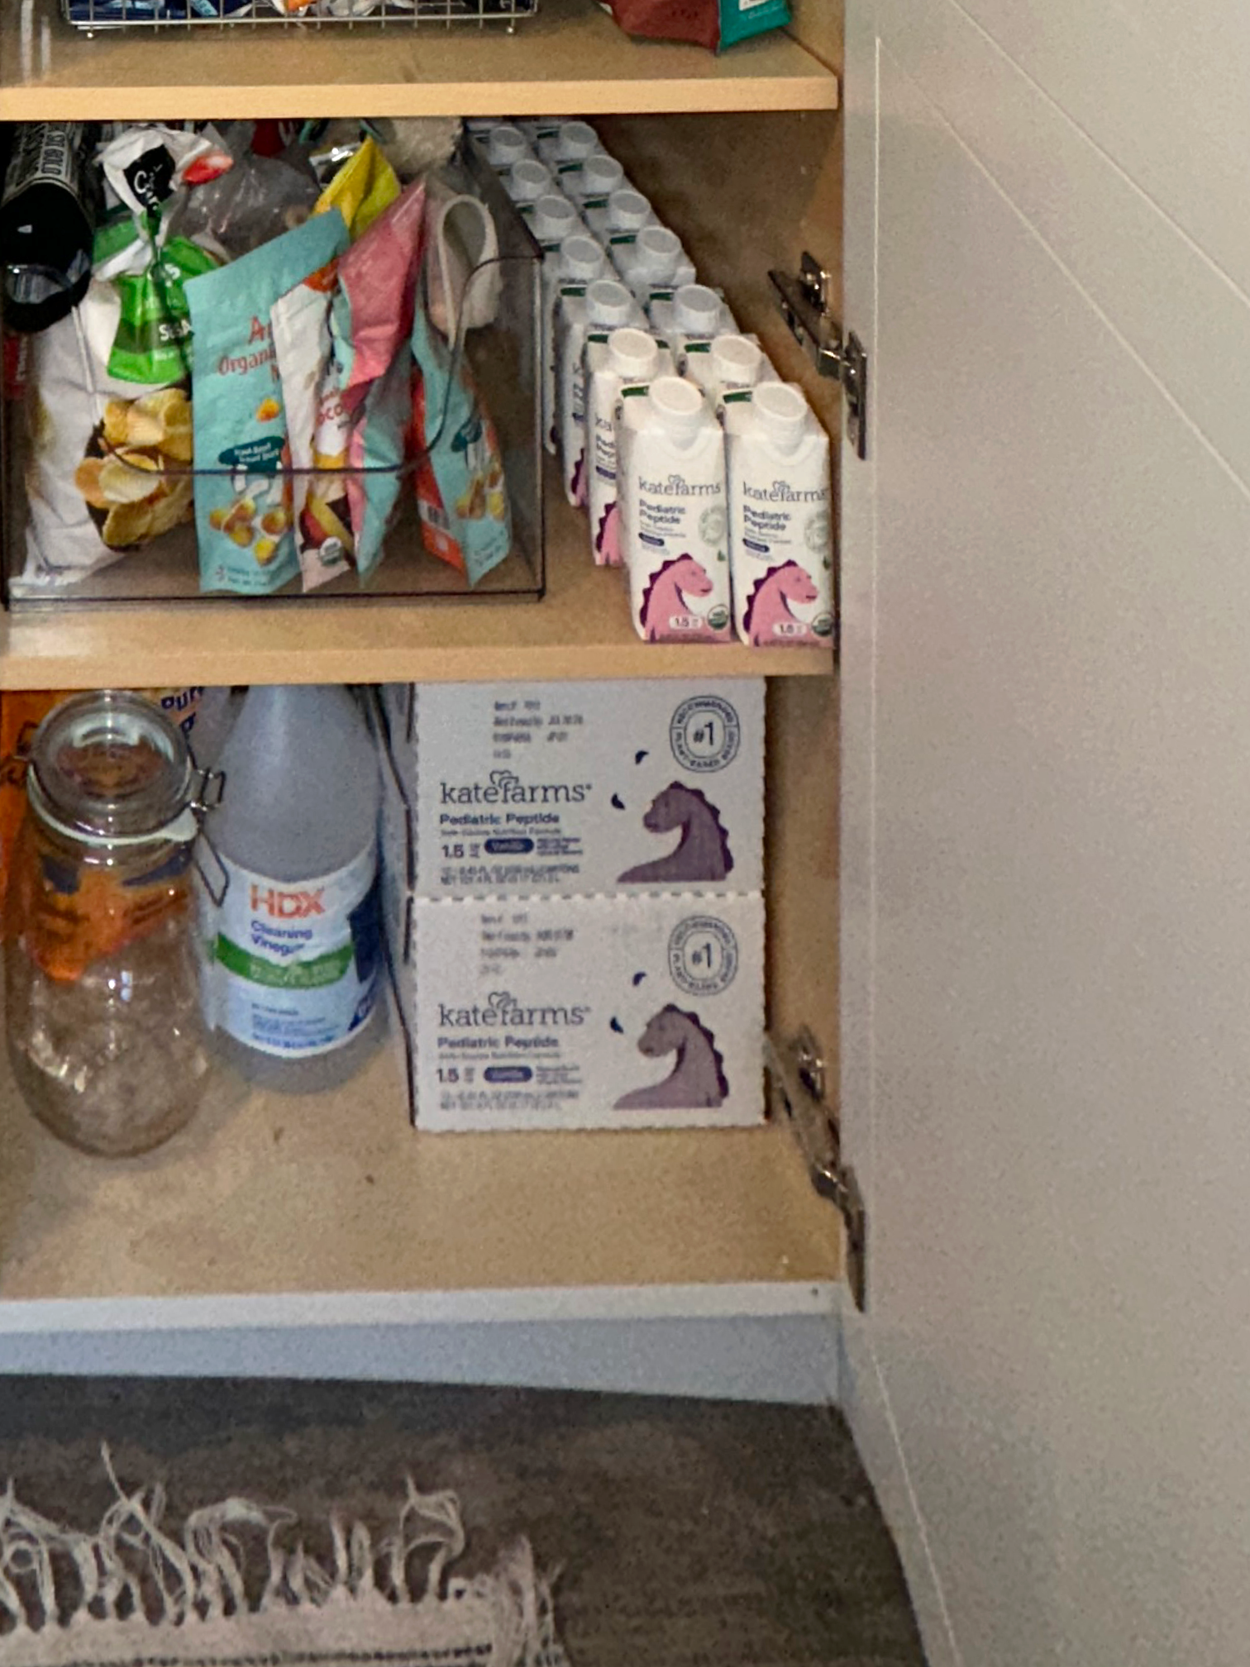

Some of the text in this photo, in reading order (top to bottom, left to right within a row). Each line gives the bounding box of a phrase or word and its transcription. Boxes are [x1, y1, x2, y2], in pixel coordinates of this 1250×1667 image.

[40, 148, 66, 176] GOLD
[638, 475, 721, 497] katefarms
[639, 498, 686, 515] Pediatric
[743, 504, 791, 521] Pediatric
[639, 509, 681, 526] Peptide
[743, 513, 786, 531] Peptide
[693, 721, 714, 746] #1
[440, 781, 587, 805] katefarms
[440, 813, 560, 826] Pediatric Peptide
[442, 844, 464, 858] 1.5
[250, 884, 326, 919] HDX
[251, 919, 313, 940] Cleaning
[251, 934, 306, 957] Vinegar
[437, 1003, 585, 1027] katefarms
[437, 1036, 559, 1049] Pediatric Peptide
[436, 1067, 459, 1083] 1.5
